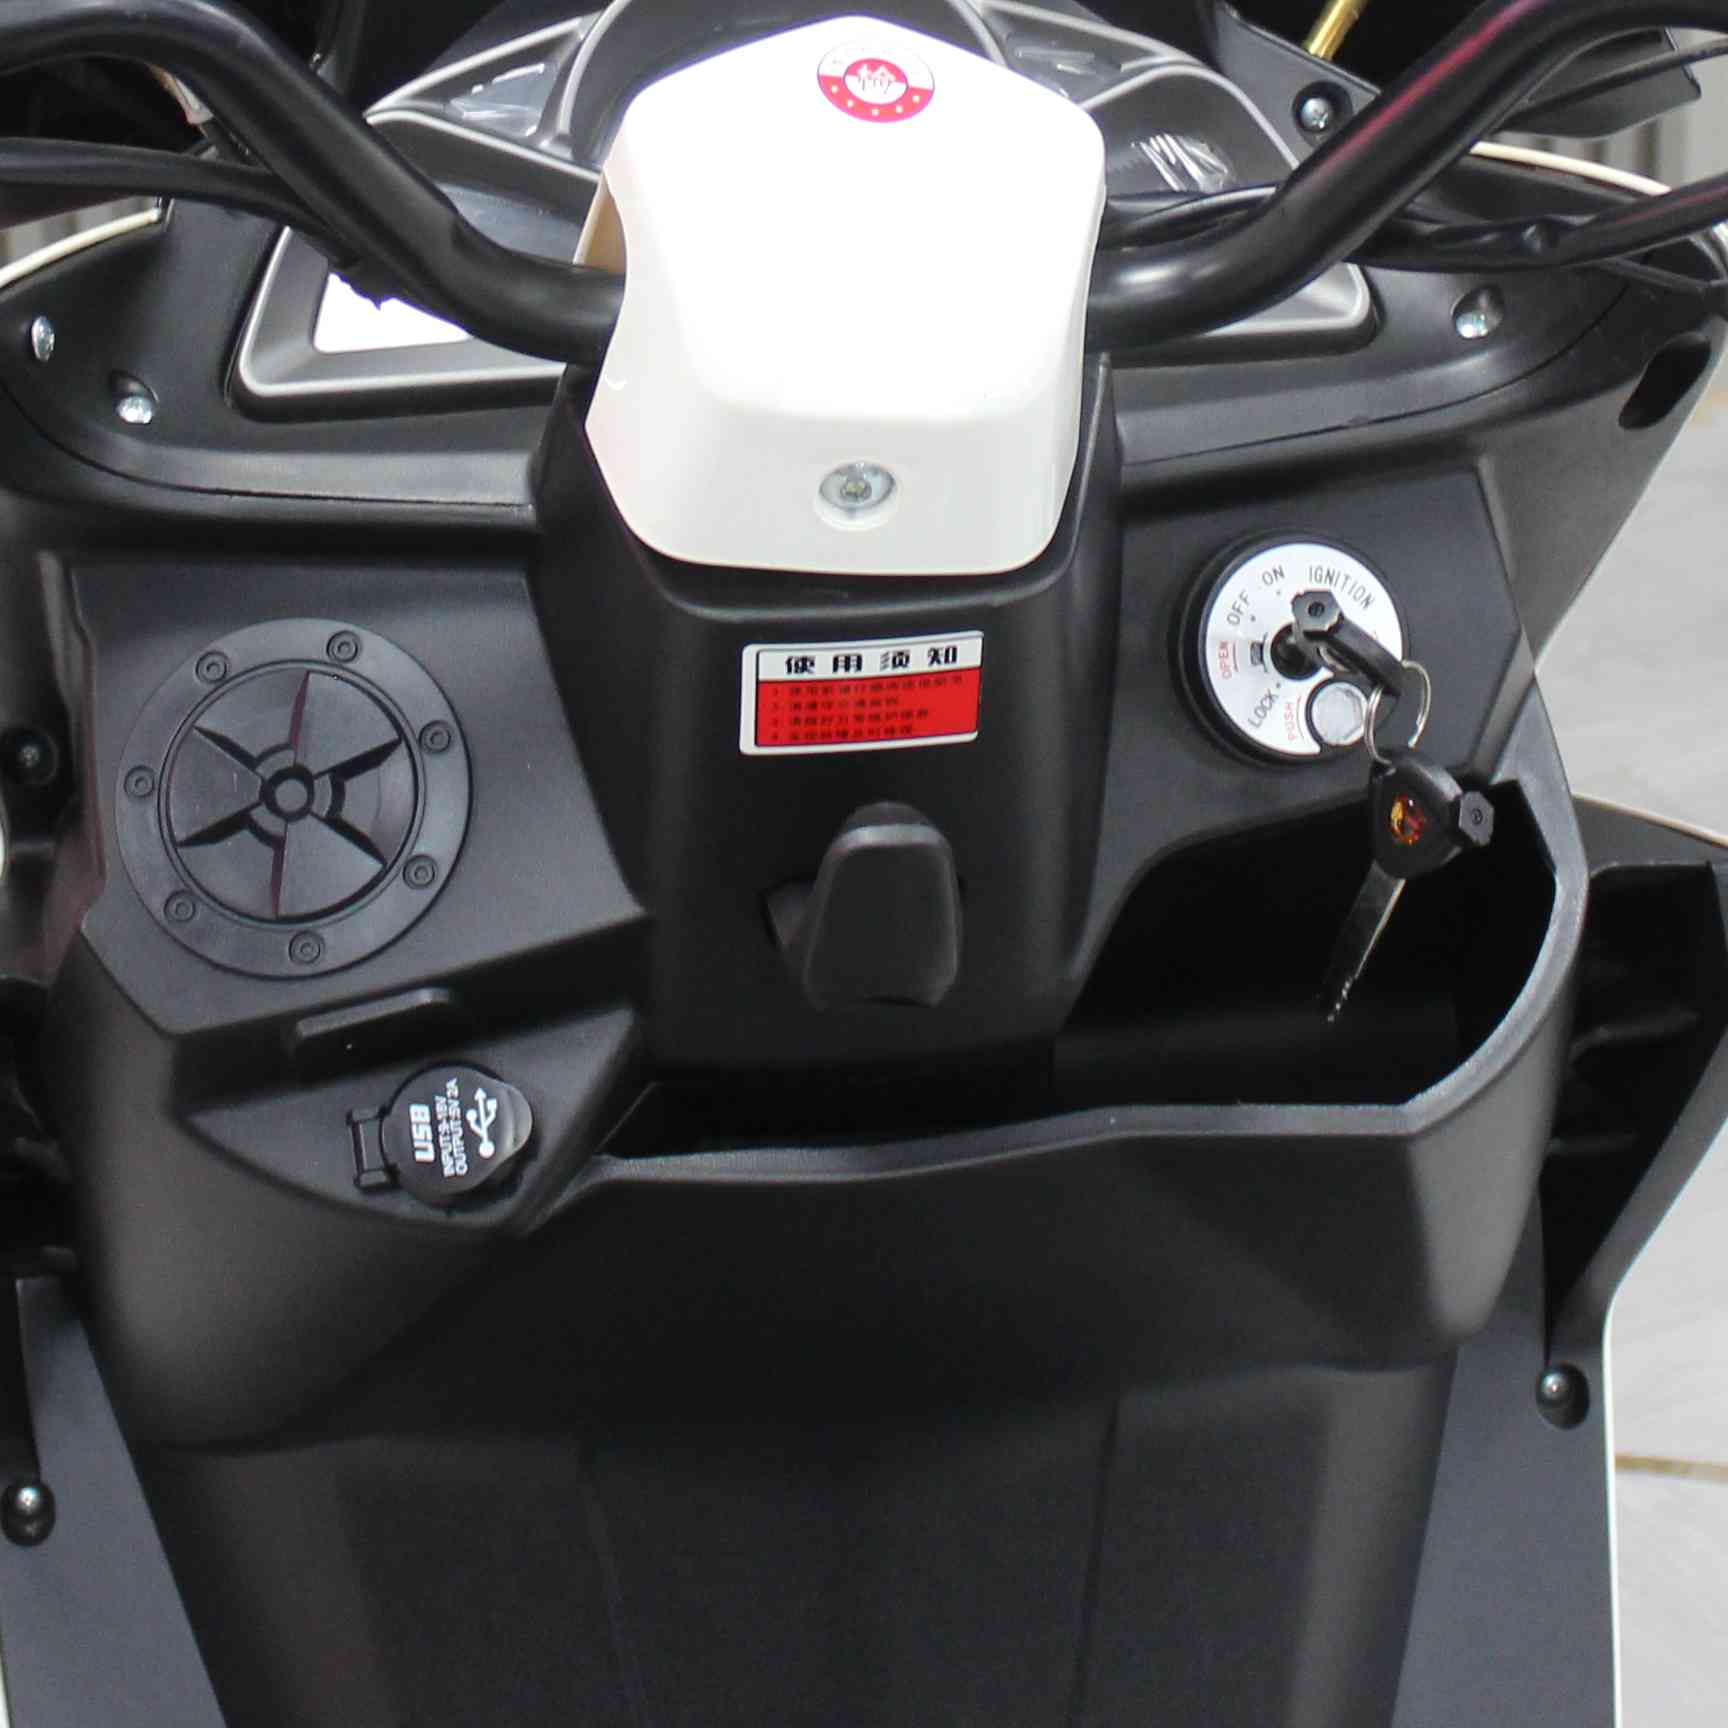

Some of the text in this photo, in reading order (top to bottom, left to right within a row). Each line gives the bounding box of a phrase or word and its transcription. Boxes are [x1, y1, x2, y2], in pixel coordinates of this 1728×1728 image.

[1262, 565, 1285, 587] ON
[1308, 565, 1375, 610] IGNITION
[1226, 590, 1252, 626] OFF
[1218, 640, 1232, 679] OPEN
[1248, 691, 1279, 728] LOCK
[1284, 702, 1298, 741] PUSH
[409, 1104, 435, 1162] USB
